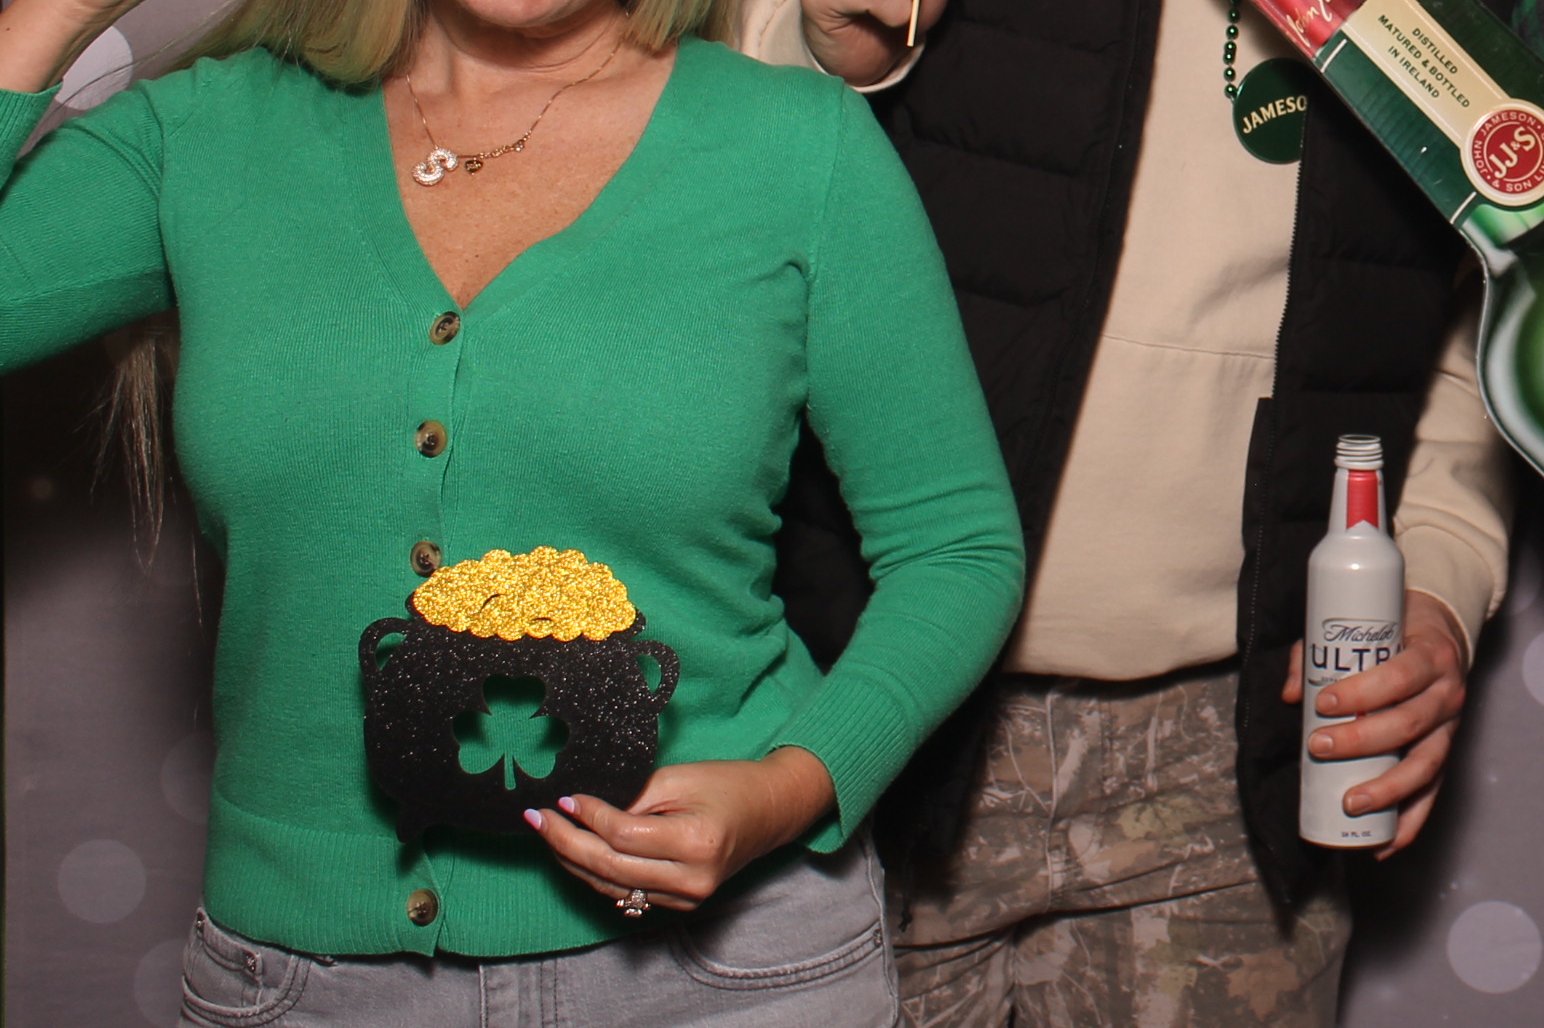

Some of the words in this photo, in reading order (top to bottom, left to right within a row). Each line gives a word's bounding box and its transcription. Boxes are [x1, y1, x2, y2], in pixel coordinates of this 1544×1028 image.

[1378, 14, 1422, 59] MATURED
[1421, 59, 1430, 69] &
[1429, 66, 1470, 108] BOTTLED
[1412, 27, 1458, 74] DISTILLED
[1388, 45, 1401, 59] IN
[1399, 57, 1440, 98] IRELAND
[1242, 95, 1308, 134] JAMESO
[1480, 111, 1537, 136] JAMESON
[1473, 140, 1488, 175] JOHN
[1491, 178, 1501, 188] &
[1505, 179, 1533, 192] SON
[1324, 623, 1395, 642] Michelob
